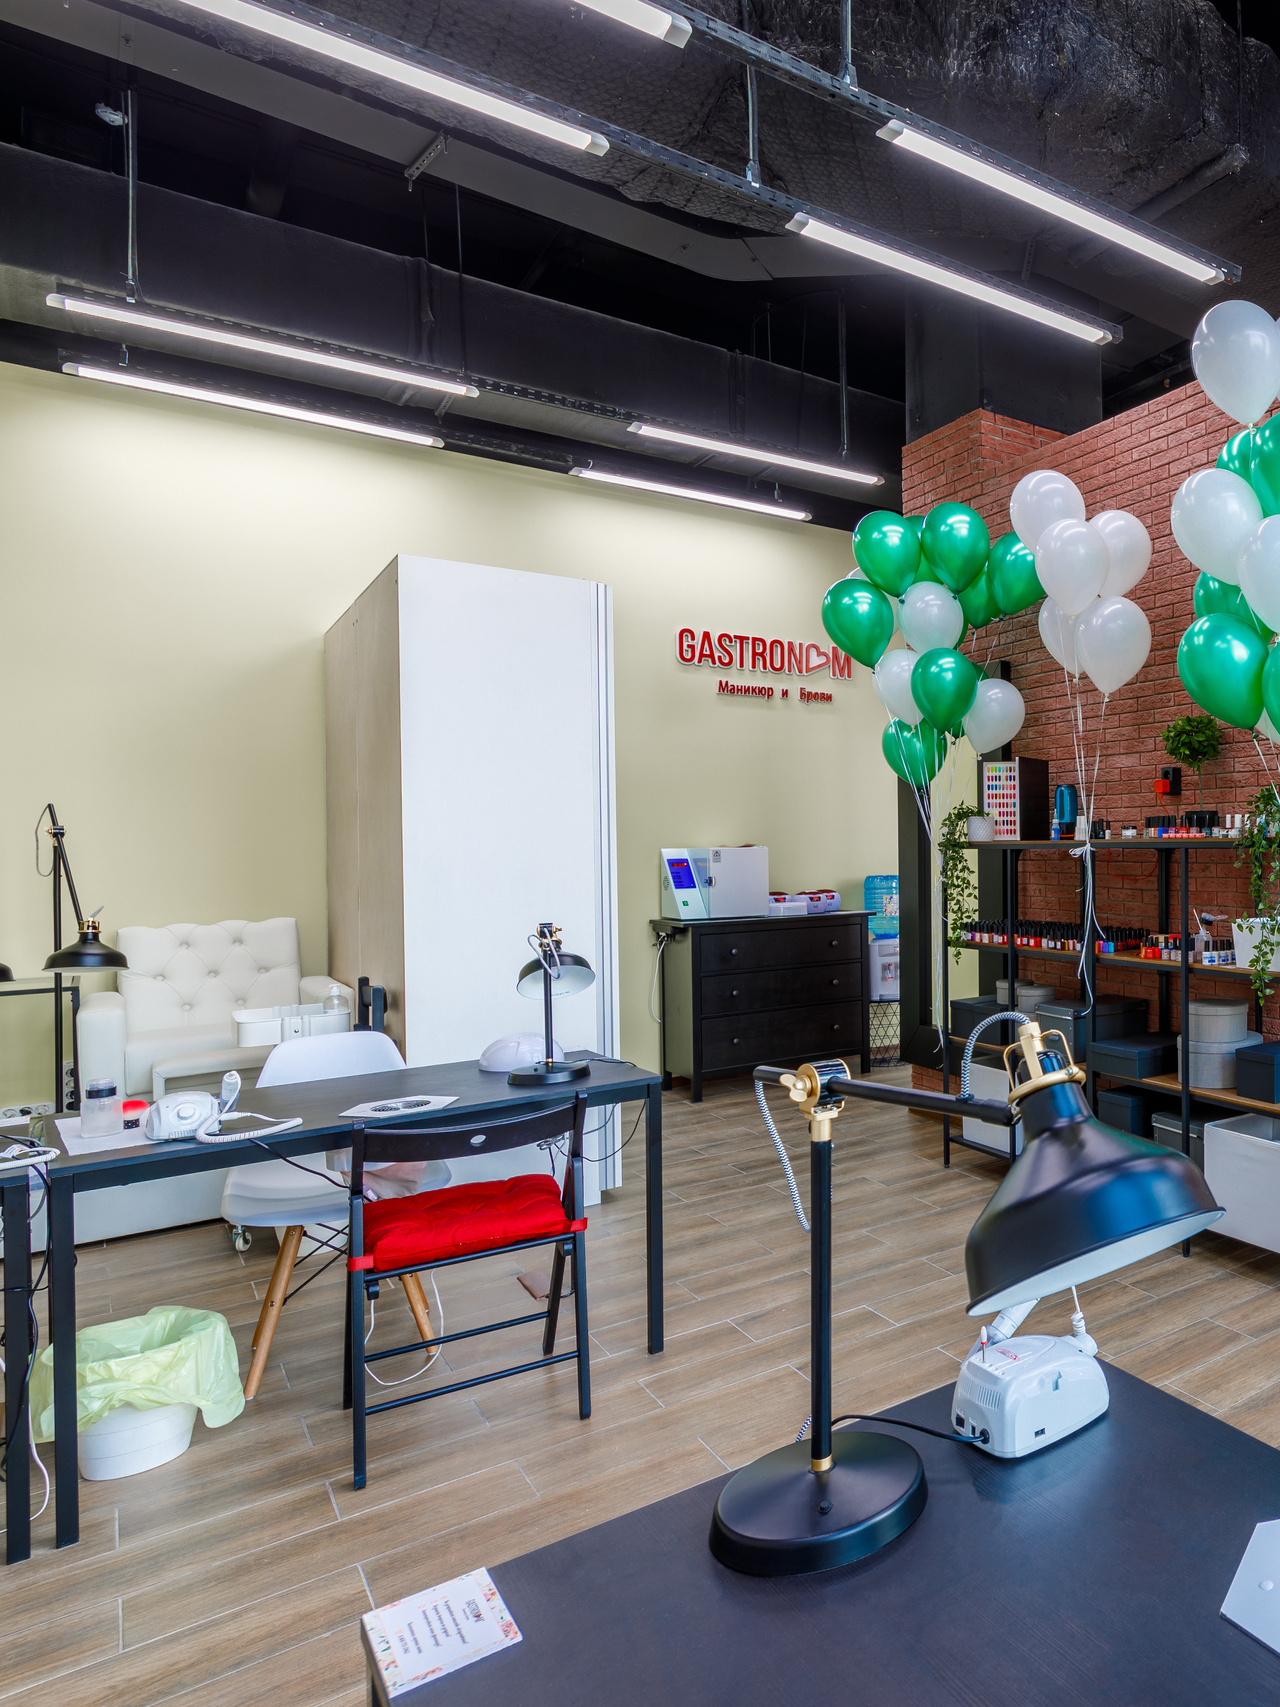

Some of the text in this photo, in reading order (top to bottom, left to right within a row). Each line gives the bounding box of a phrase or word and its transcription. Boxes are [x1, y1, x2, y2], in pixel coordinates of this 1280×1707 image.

[717, 679, 833, 703] Маникюр и Брови
